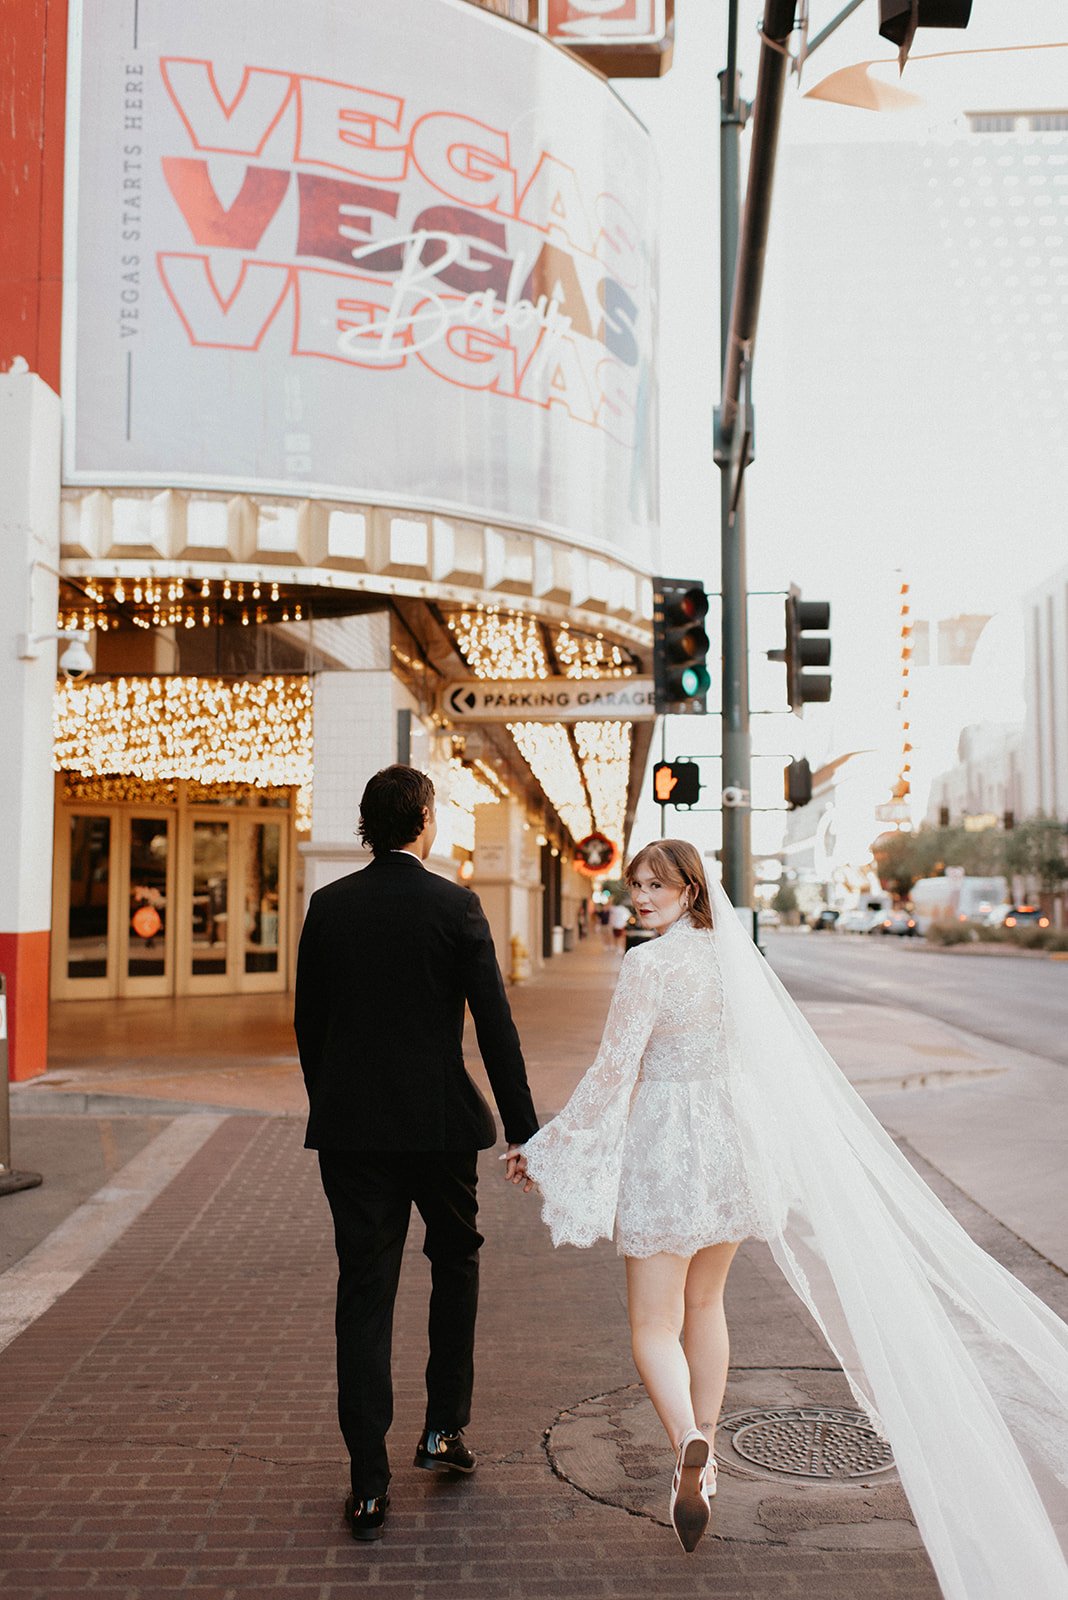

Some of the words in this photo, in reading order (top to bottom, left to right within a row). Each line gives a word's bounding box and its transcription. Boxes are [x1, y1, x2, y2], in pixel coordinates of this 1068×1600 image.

[124, 63, 144, 131] HERE
[121, 145, 143, 242] STARTS
[159, 56, 640, 289] VEGAS
[119, 255, 141, 339] VEGAS
[160, 156, 639, 367] VEGAS
[337, 228, 573, 357] Baby
[156, 251, 640, 449] VEGAS
[483, 691, 570, 707] PARKING
